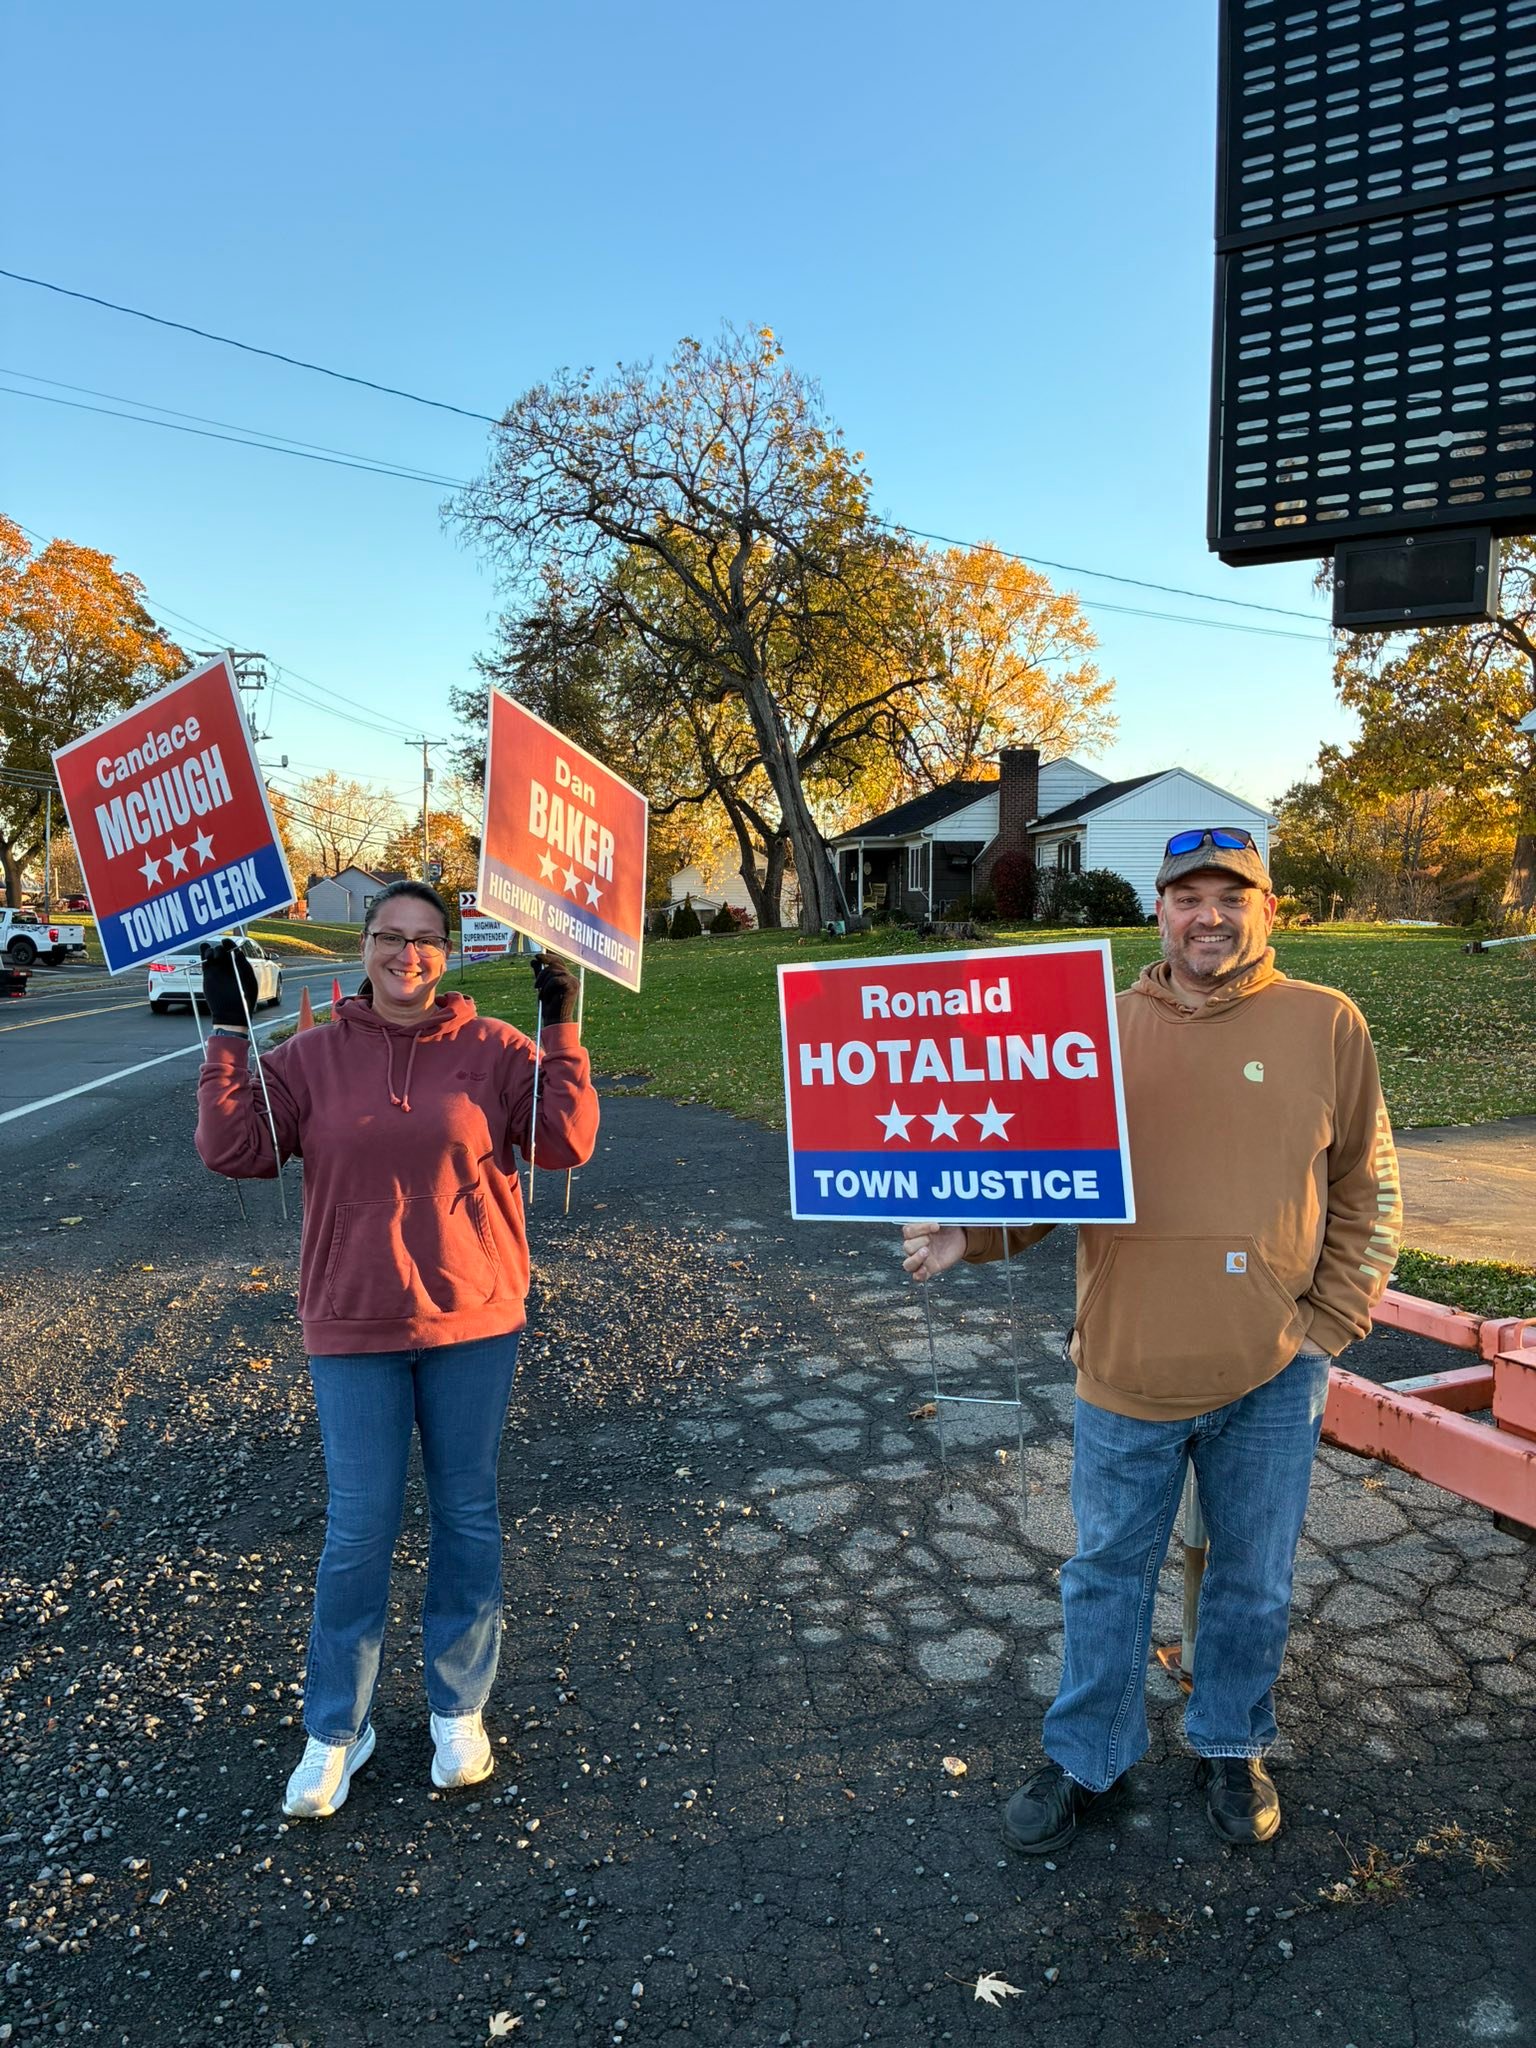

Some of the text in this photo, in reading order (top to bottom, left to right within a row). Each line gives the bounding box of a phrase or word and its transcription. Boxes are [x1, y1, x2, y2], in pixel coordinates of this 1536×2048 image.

[96, 716, 201, 789] Candace
[94, 743, 233, 860] MCHUGH
[554, 755, 596, 809] Dan
[528, 778, 615, 883] BAKER
[119, 857, 267, 953] TOWN CLERK
[474, 921, 501, 931] HIGHWAY
[488, 871, 636, 971] HIGHWAY SUPERINTENDENT
[463, 932, 508, 942] SUPERINTENDENT
[861, 977, 1012, 1020] Ronald
[799, 1031, 1099, 1086] HOTALING
[813, 1169, 1100, 1200] TOWN JUSTICE
